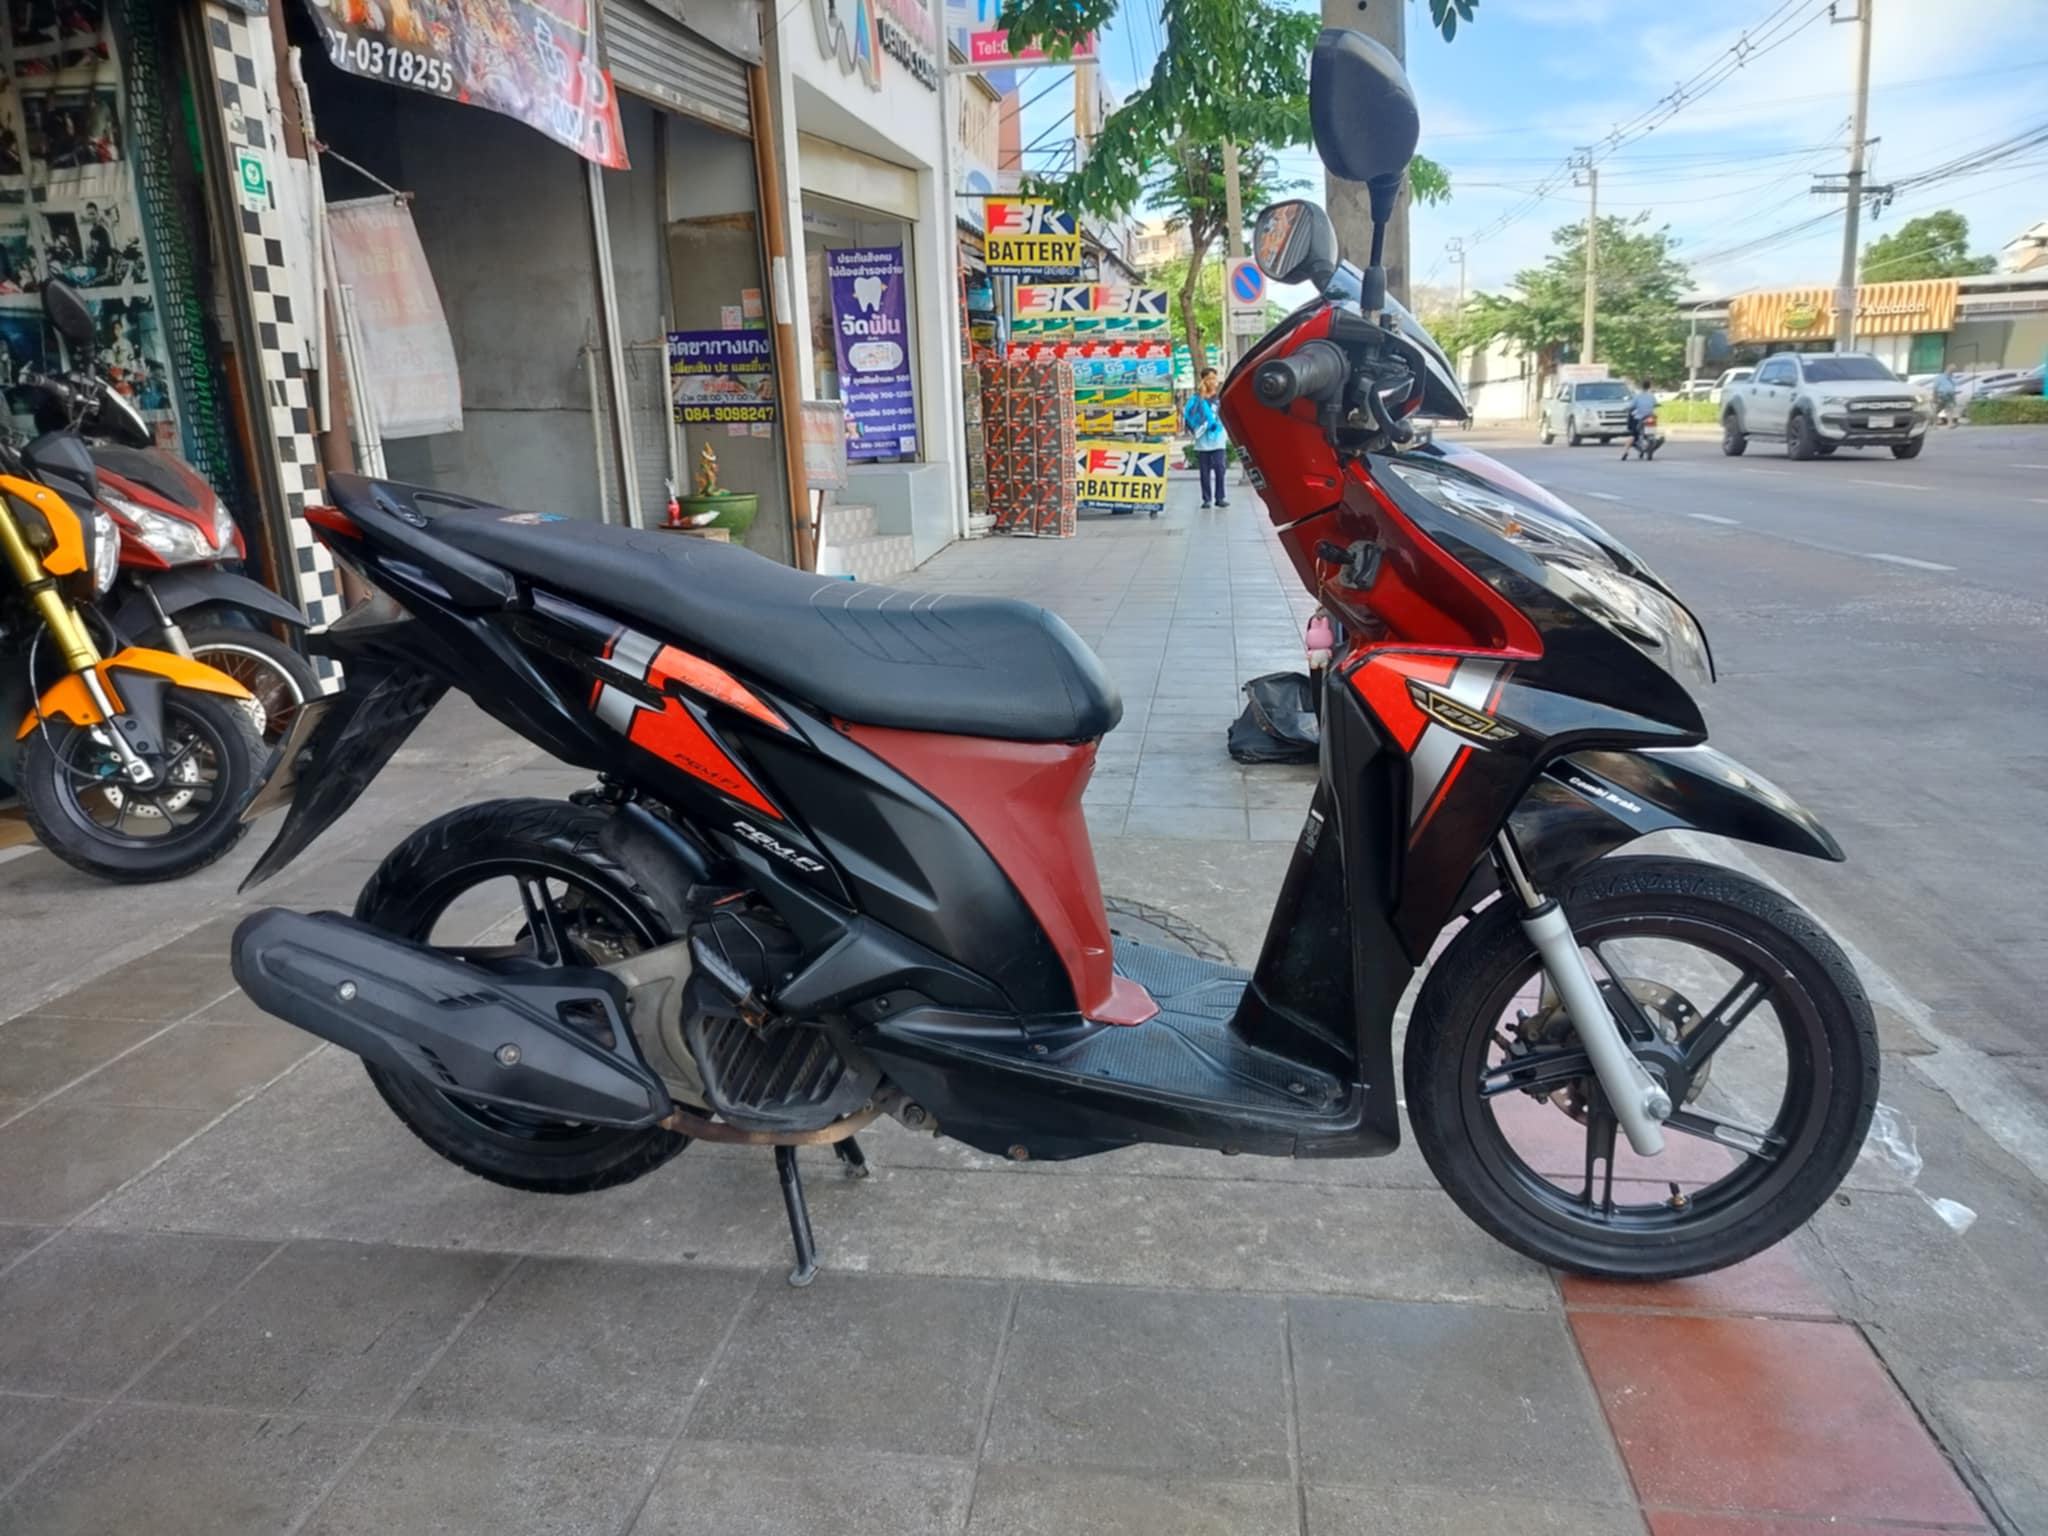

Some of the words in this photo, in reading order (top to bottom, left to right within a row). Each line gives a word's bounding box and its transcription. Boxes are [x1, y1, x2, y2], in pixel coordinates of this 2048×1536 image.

[988, 241, 1076, 261] BATTERY
[841, 313, 901, 335] จัดฟัน
[684, 406, 774, 422] 084-9098247
[1087, 479, 1163, 499] BATTERY
[1569, 776, 1609, 798] Combi
[1606, 793, 1642, 814] Brake
